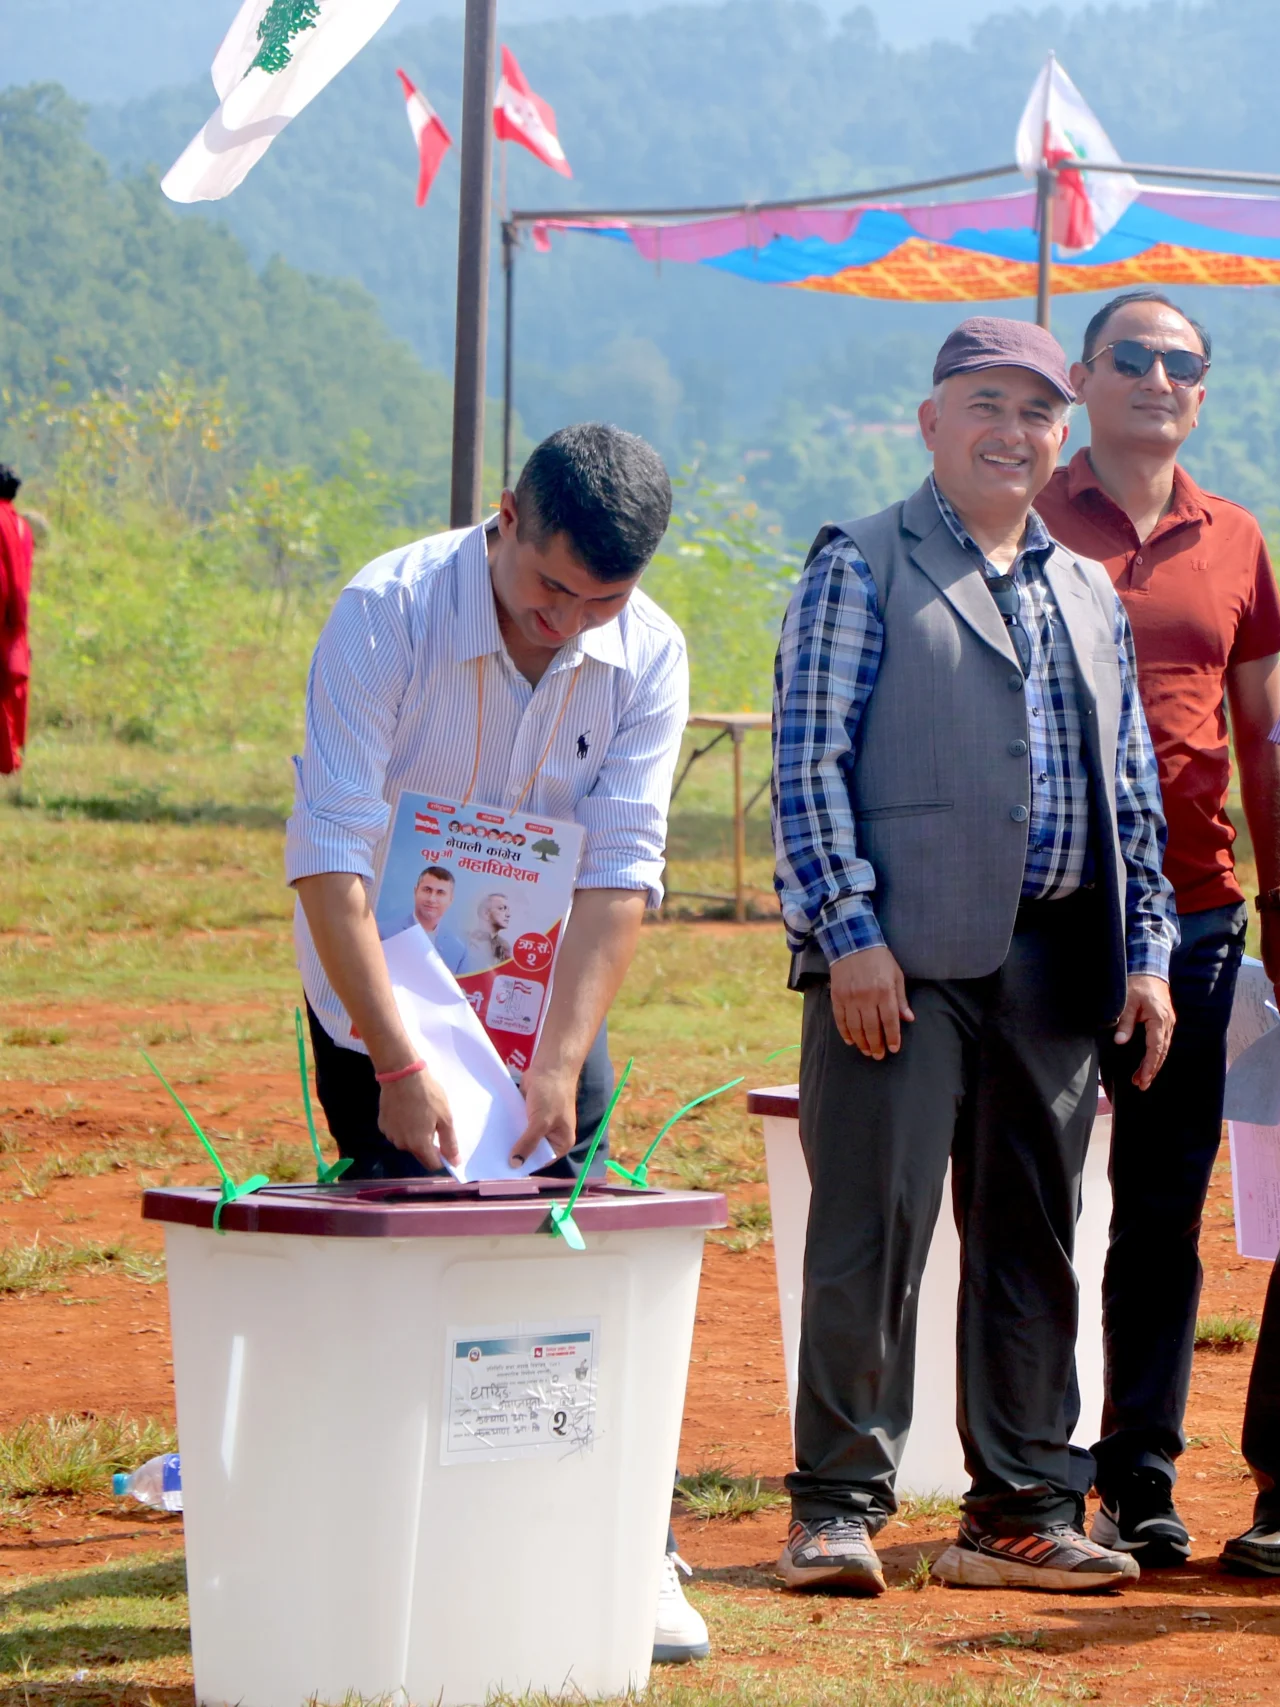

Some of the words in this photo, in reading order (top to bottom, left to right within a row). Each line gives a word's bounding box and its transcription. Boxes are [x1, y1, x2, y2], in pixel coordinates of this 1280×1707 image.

[445, 838, 481, 854] नेपाली
[486, 844, 521, 862] कांग्रेस
[458, 855, 540, 884] महाधिवेशन
[526, 954, 536, 967] २
[552, 1411, 568, 1436] २
